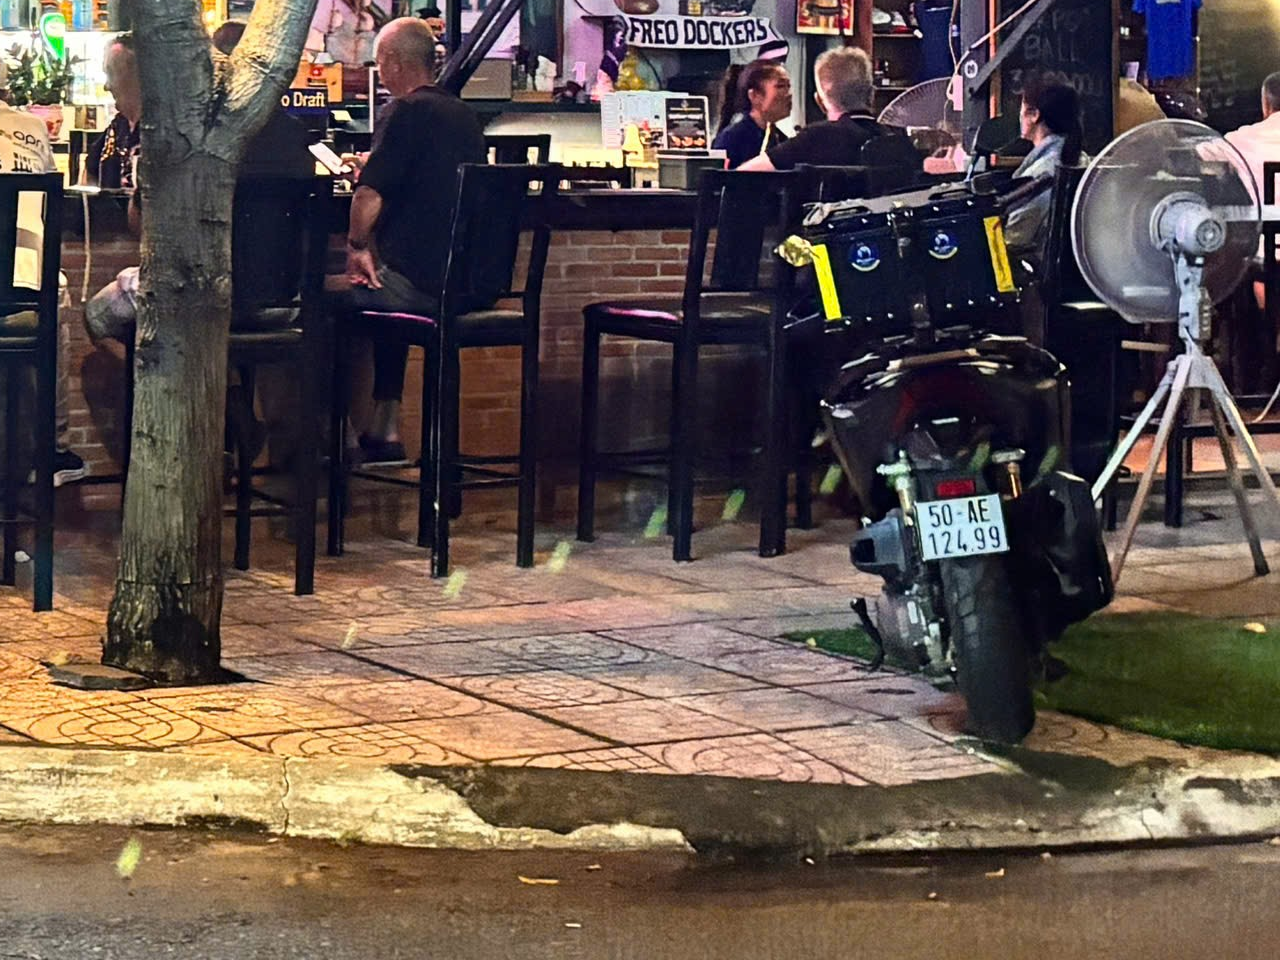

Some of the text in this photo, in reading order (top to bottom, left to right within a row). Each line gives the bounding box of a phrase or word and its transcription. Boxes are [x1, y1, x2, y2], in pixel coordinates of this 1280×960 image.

[684, 18, 767, 46] DOCKERS
[293, 91, 326, 108] Draft
[928, 526, 1002, 556] 124.99
